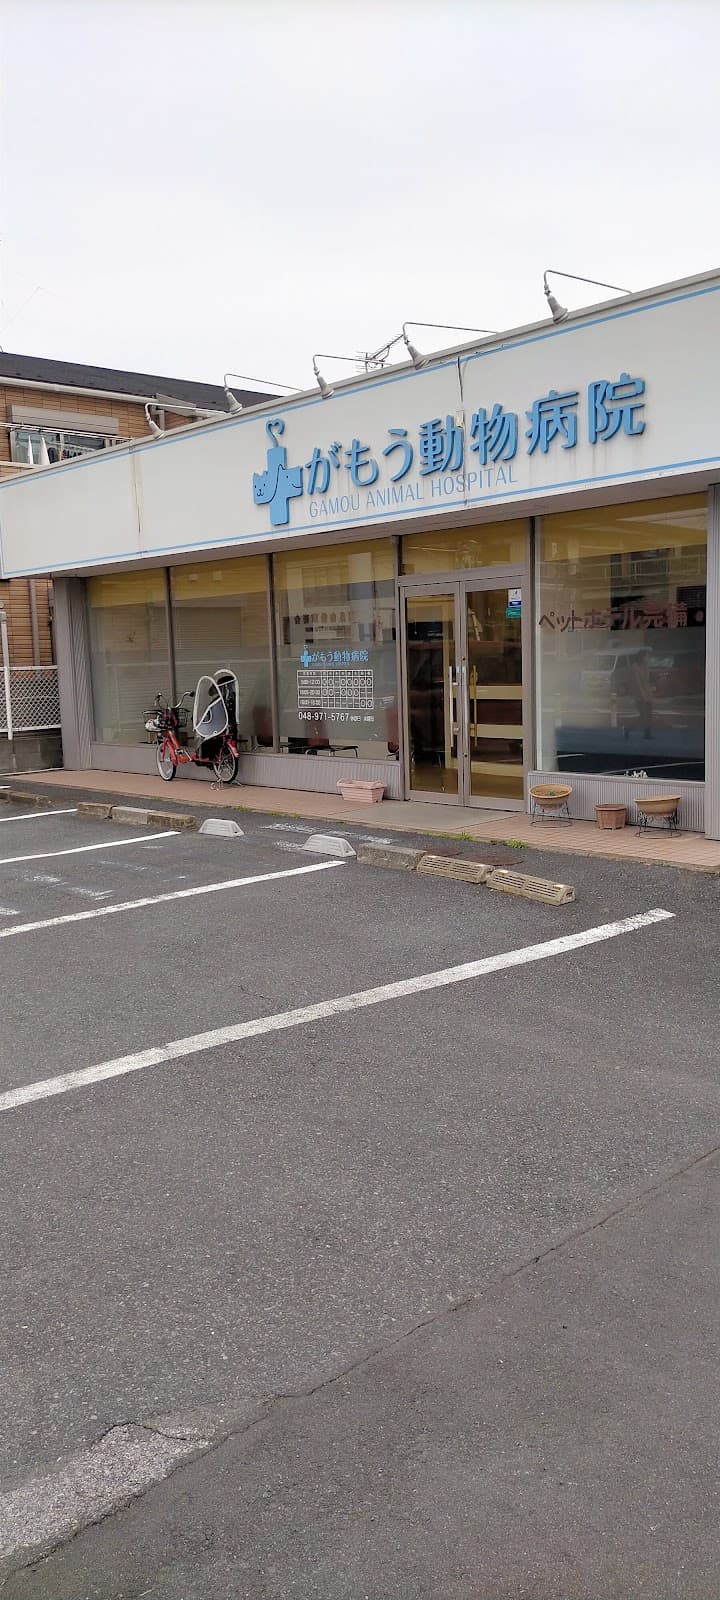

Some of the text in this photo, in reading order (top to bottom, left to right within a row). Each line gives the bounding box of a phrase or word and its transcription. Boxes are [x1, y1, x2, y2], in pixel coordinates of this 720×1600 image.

[305, 373, 646, 496] がもう動物病院
[308, 468, 518, 518] GAMOU ANIMAL HOSPITAL
[311, 650, 369, 662] がもう動物病院
[298, 711, 349, 722] 048-971-5767
